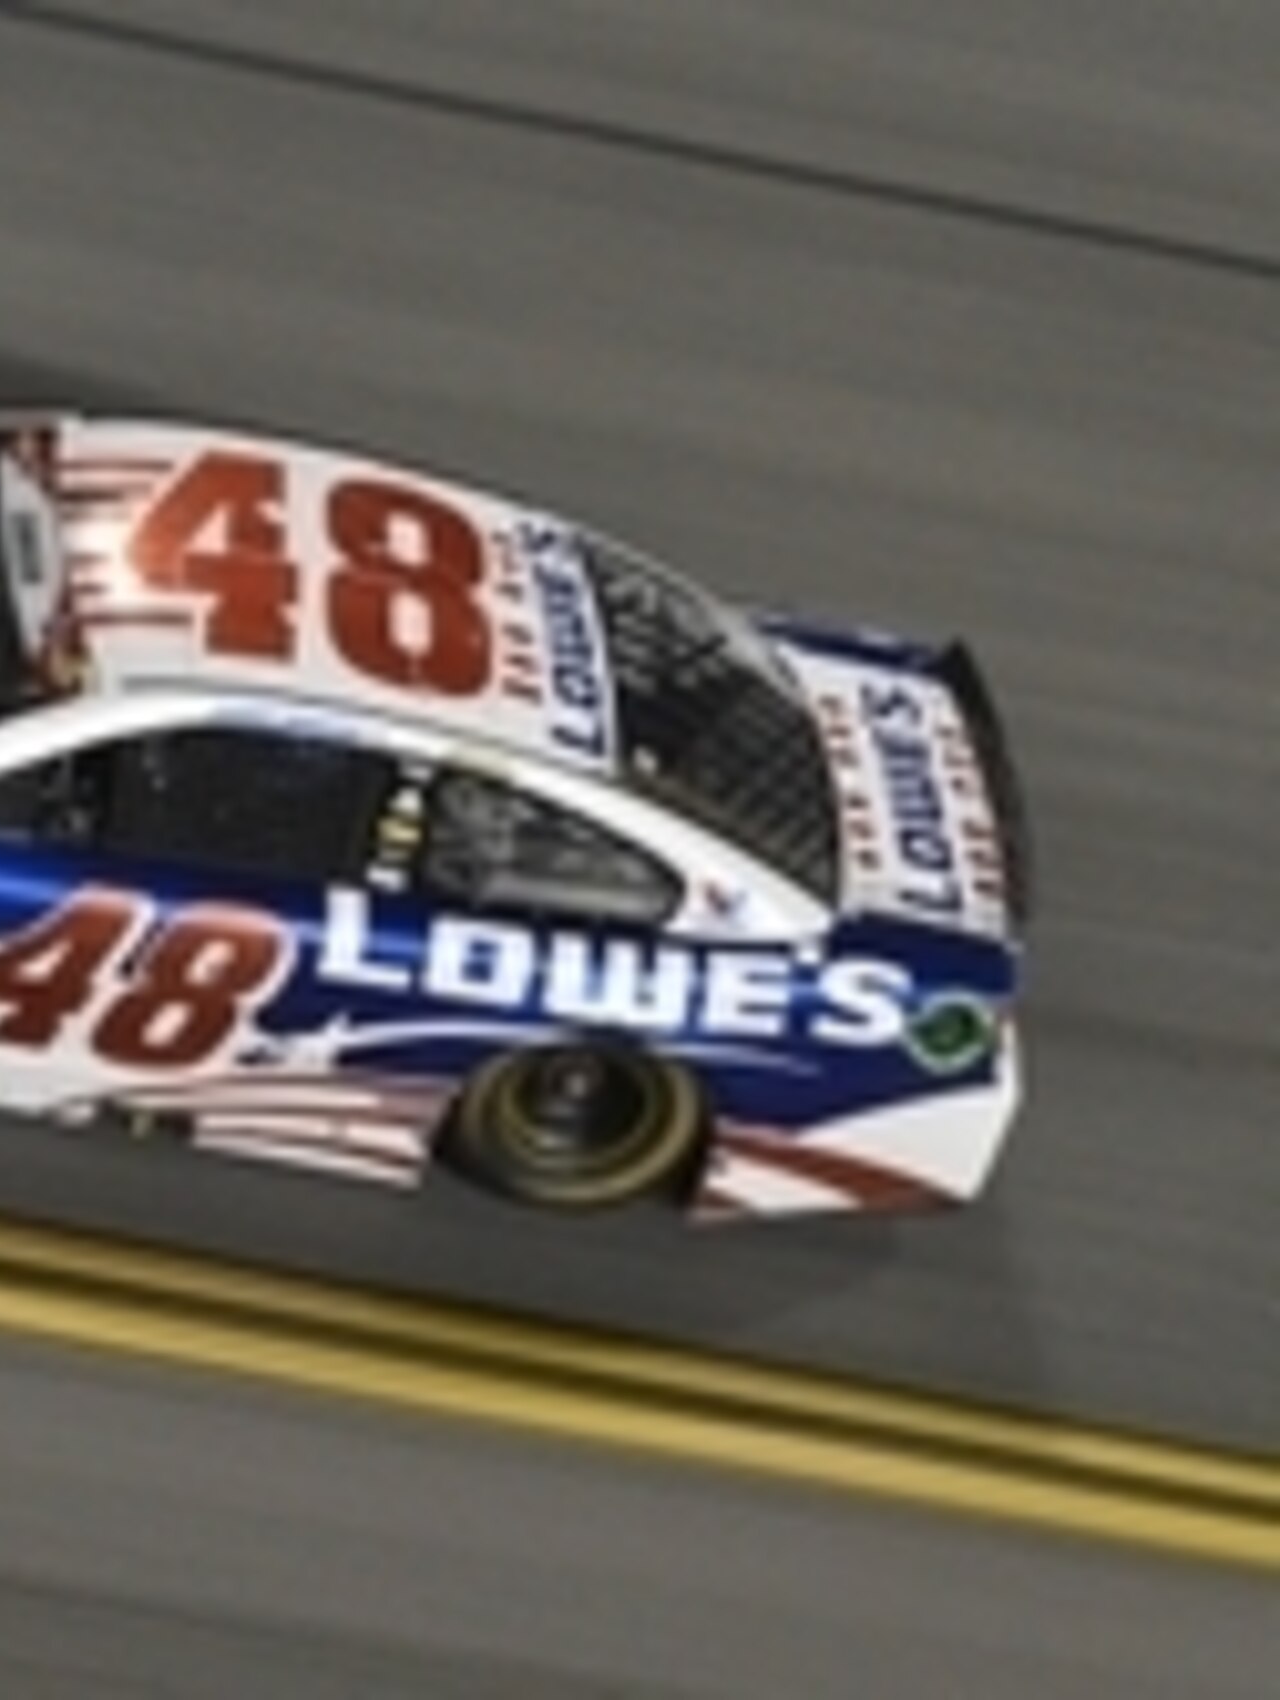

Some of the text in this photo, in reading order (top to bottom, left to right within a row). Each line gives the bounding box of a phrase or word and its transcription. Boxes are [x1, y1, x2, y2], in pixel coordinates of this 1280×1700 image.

[124, 447, 496, 702] 48
[859, 684, 963, 911] LOWE'S
[317, 886, 914, 1045] LOWE'S
